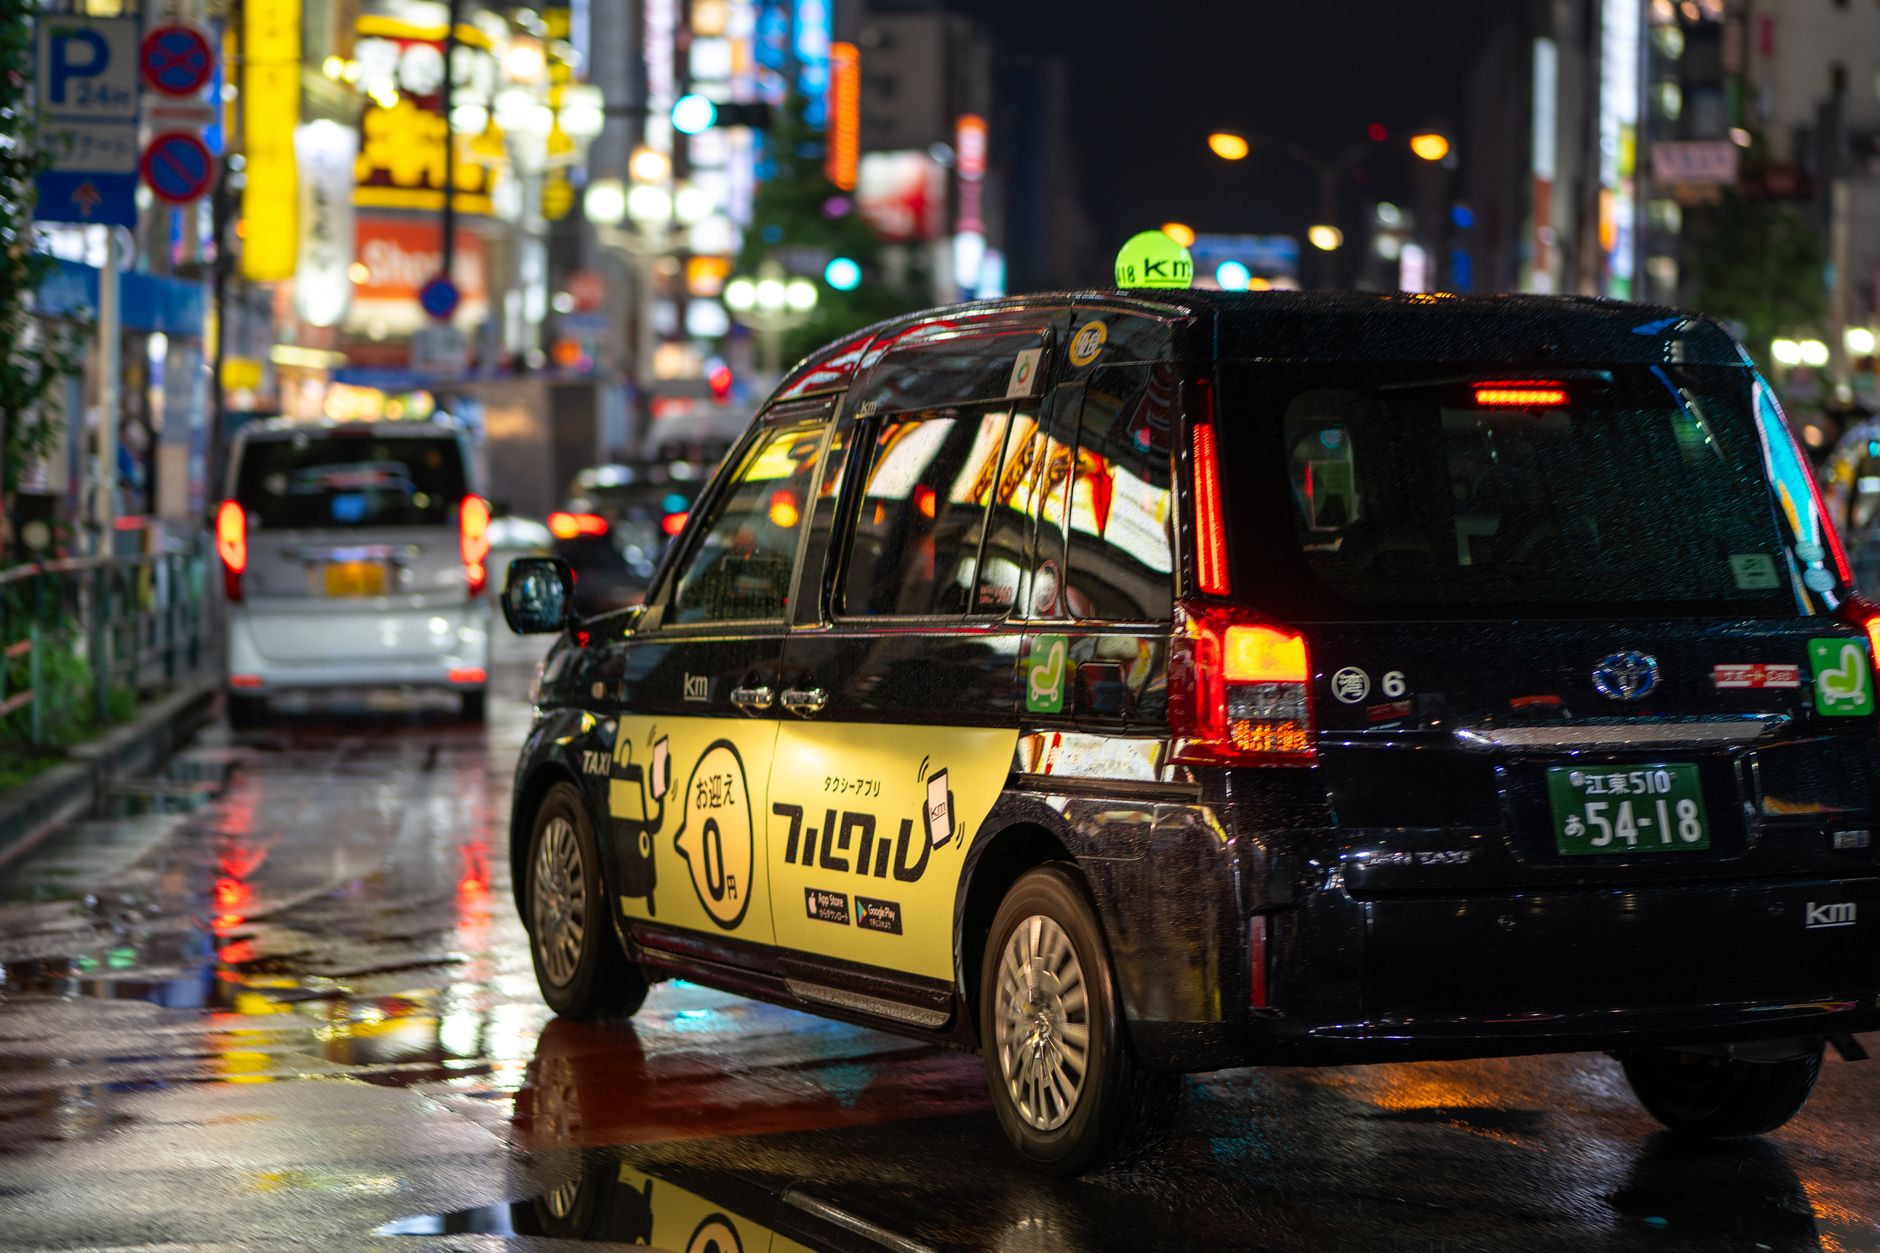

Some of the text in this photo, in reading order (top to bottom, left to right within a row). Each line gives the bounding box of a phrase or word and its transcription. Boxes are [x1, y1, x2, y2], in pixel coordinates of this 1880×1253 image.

[50, 28, 110, 104] P
[683, 672, 708, 700] km
[1381, 670, 1406, 698] 6
[582, 751, 612, 776] TAXI
[696, 774, 735, 809] お迎え
[824, 776, 881, 798] タクシーアプリ
[930, 802, 946, 822] km
[1564, 799, 1702, 847] あ 54-18
[818, 892, 844, 907] App Store
